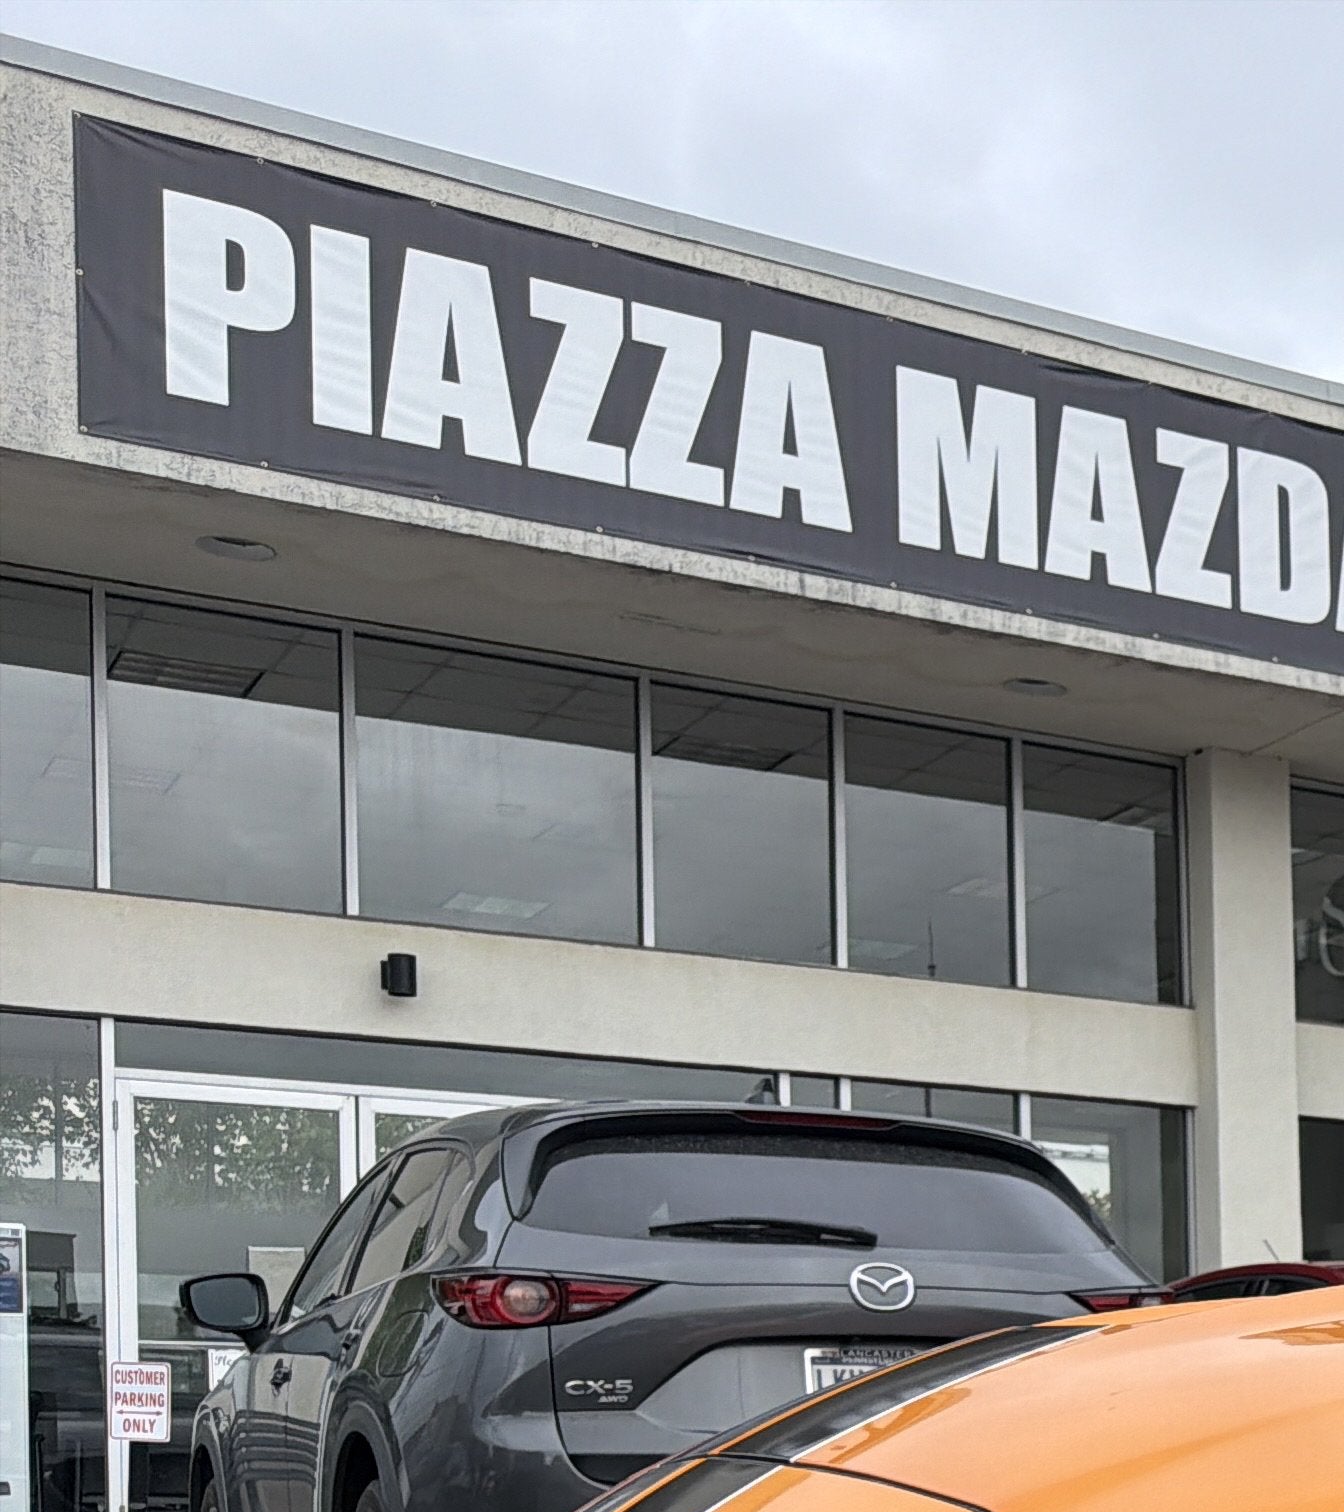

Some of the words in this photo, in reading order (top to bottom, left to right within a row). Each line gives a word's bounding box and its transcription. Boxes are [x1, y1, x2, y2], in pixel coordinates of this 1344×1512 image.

[162, 188, 853, 533] PIAZZA
[114, 1368, 166, 1386] CUSTOMER
[564, 1379, 634, 1396] CX-5
[114, 1391, 165, 1408] PARKING
[598, 1395, 629, 1403] AWD
[122, 1418, 157, 1434] ONLY
